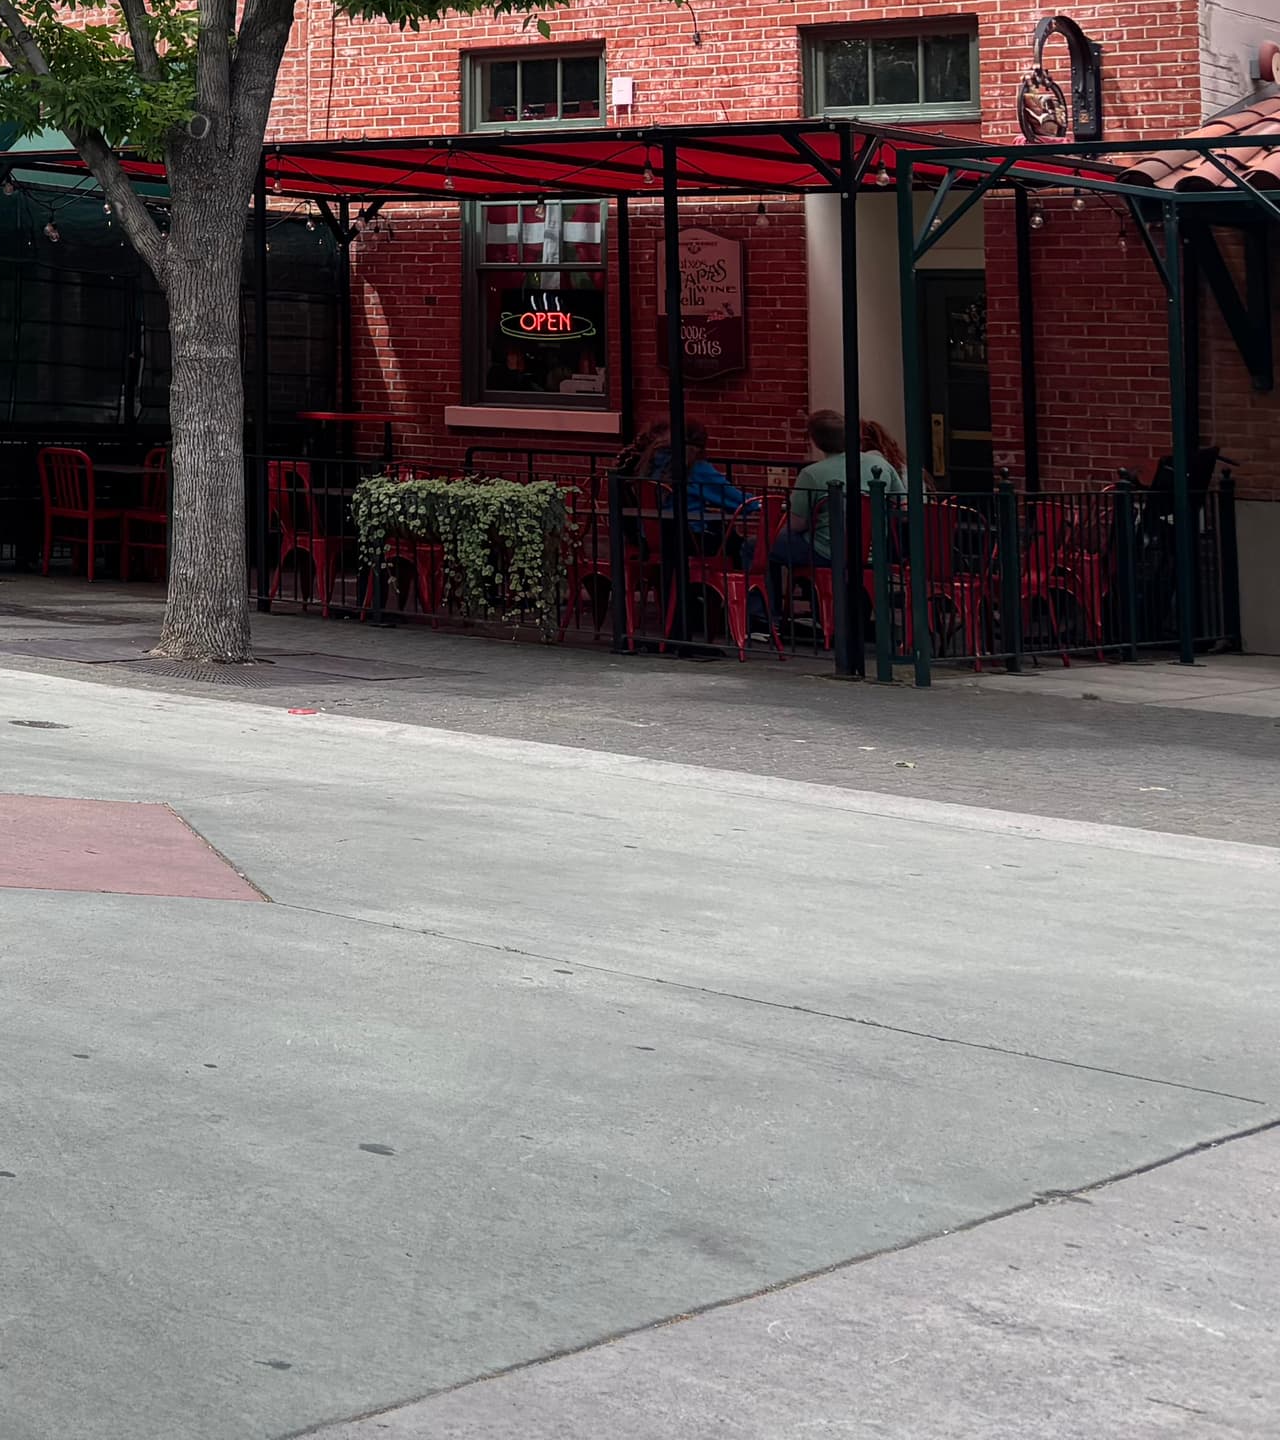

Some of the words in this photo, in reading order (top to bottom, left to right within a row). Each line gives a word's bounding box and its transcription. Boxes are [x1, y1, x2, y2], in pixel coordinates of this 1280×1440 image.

[680, 287, 705, 306] ella
[696, 285, 737, 294] WINE
[520, 312, 571, 331] OPEN
